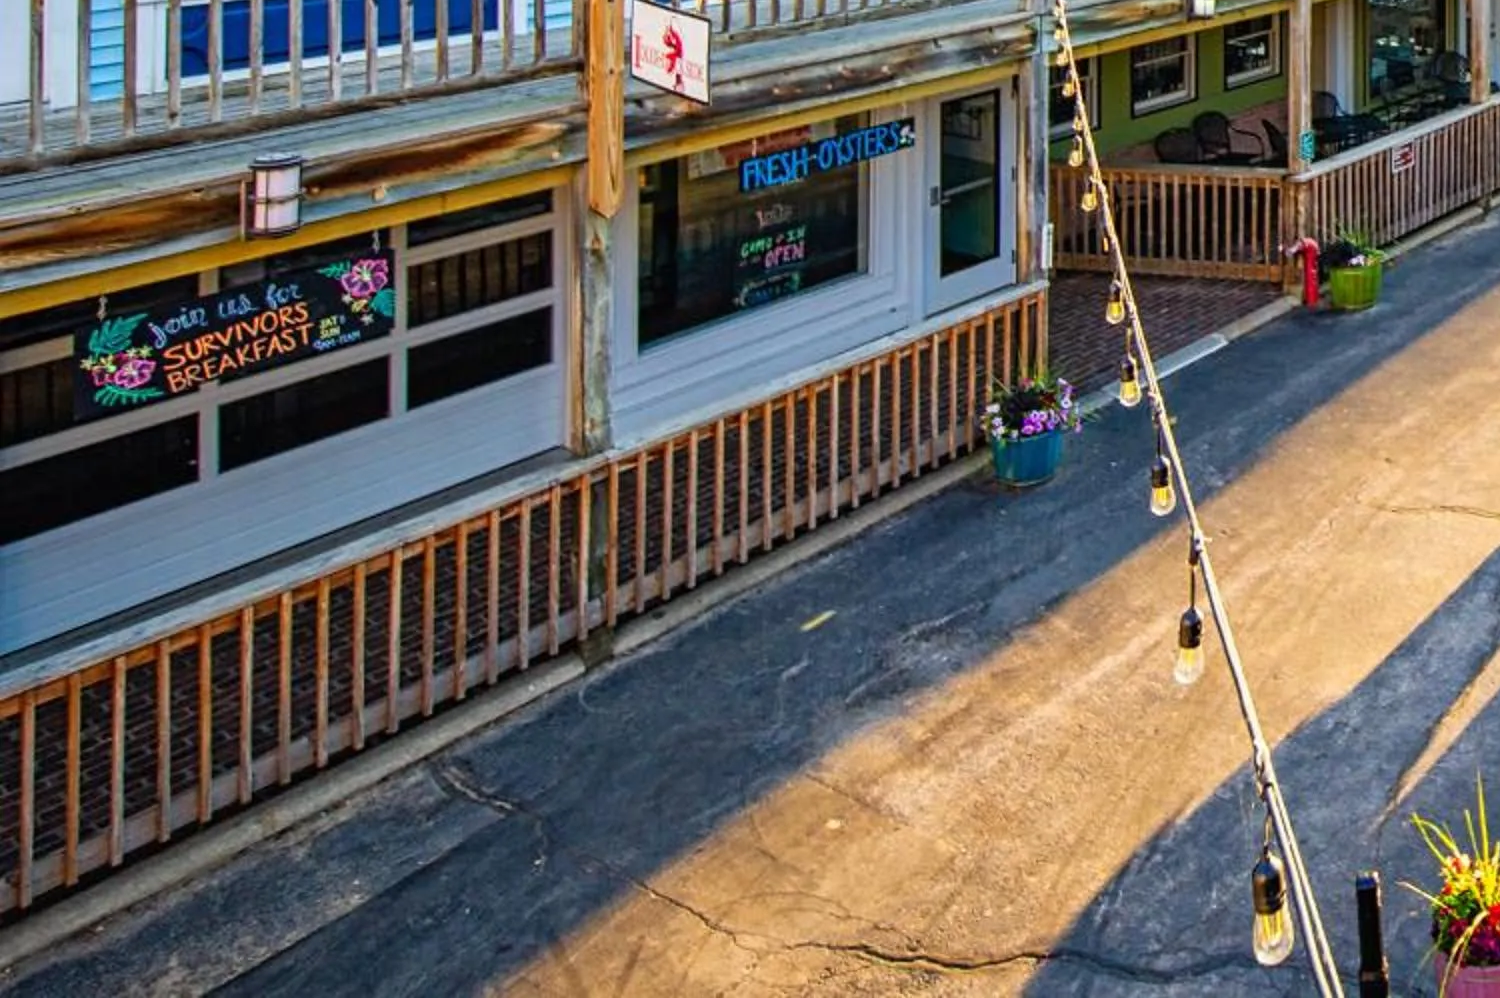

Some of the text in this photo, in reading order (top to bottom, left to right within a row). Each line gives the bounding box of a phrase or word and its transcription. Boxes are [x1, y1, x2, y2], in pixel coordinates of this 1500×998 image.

[765, 240, 806, 268] OPEN
[217, 293, 258, 319] us
[265, 283, 303, 310] for
[163, 302, 310, 370] SURVIVORS
[166, 322, 315, 393] BREAKFAST
